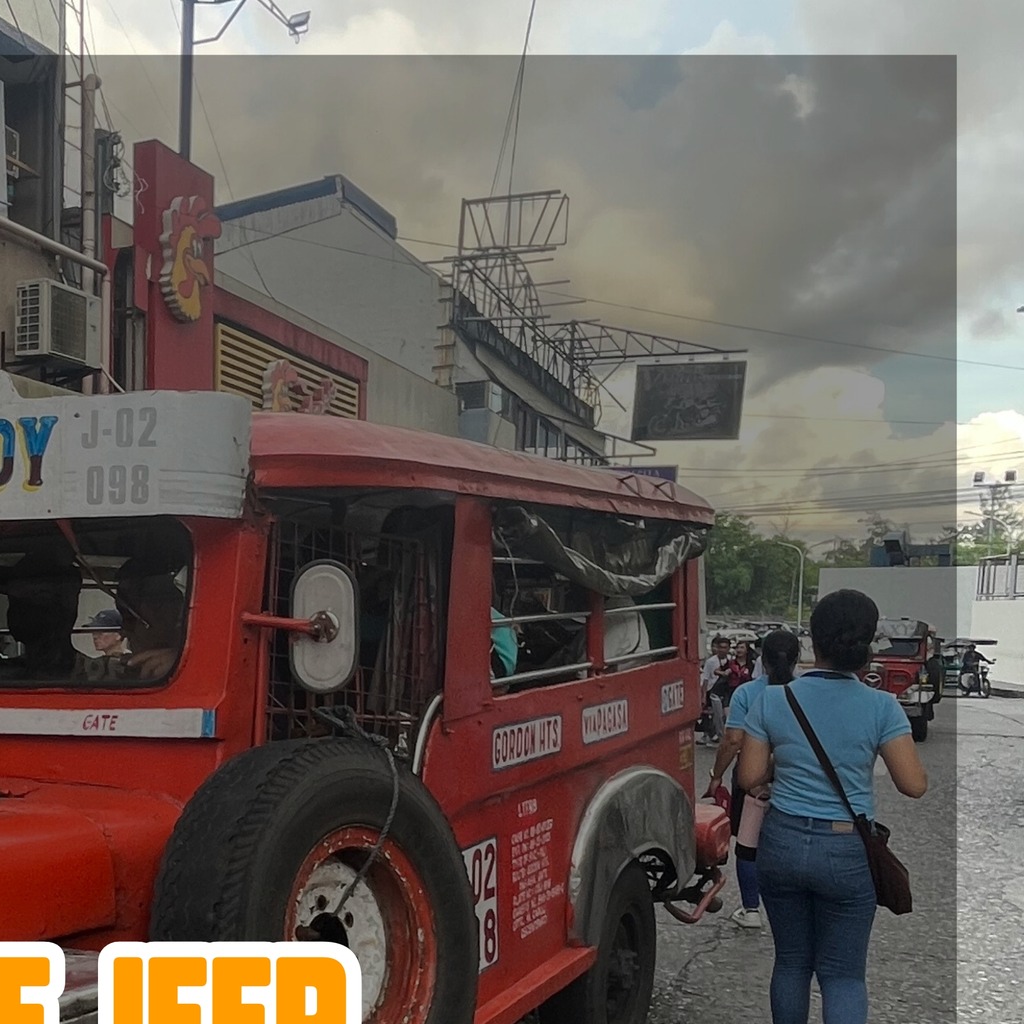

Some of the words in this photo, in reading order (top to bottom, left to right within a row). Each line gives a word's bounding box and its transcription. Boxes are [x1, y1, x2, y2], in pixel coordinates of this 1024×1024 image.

[81, 406, 157, 449] J-02
[86, 464, 149, 505] 098
[82, 714, 118, 731] GATE
[494, 726, 536, 765] GORDON
